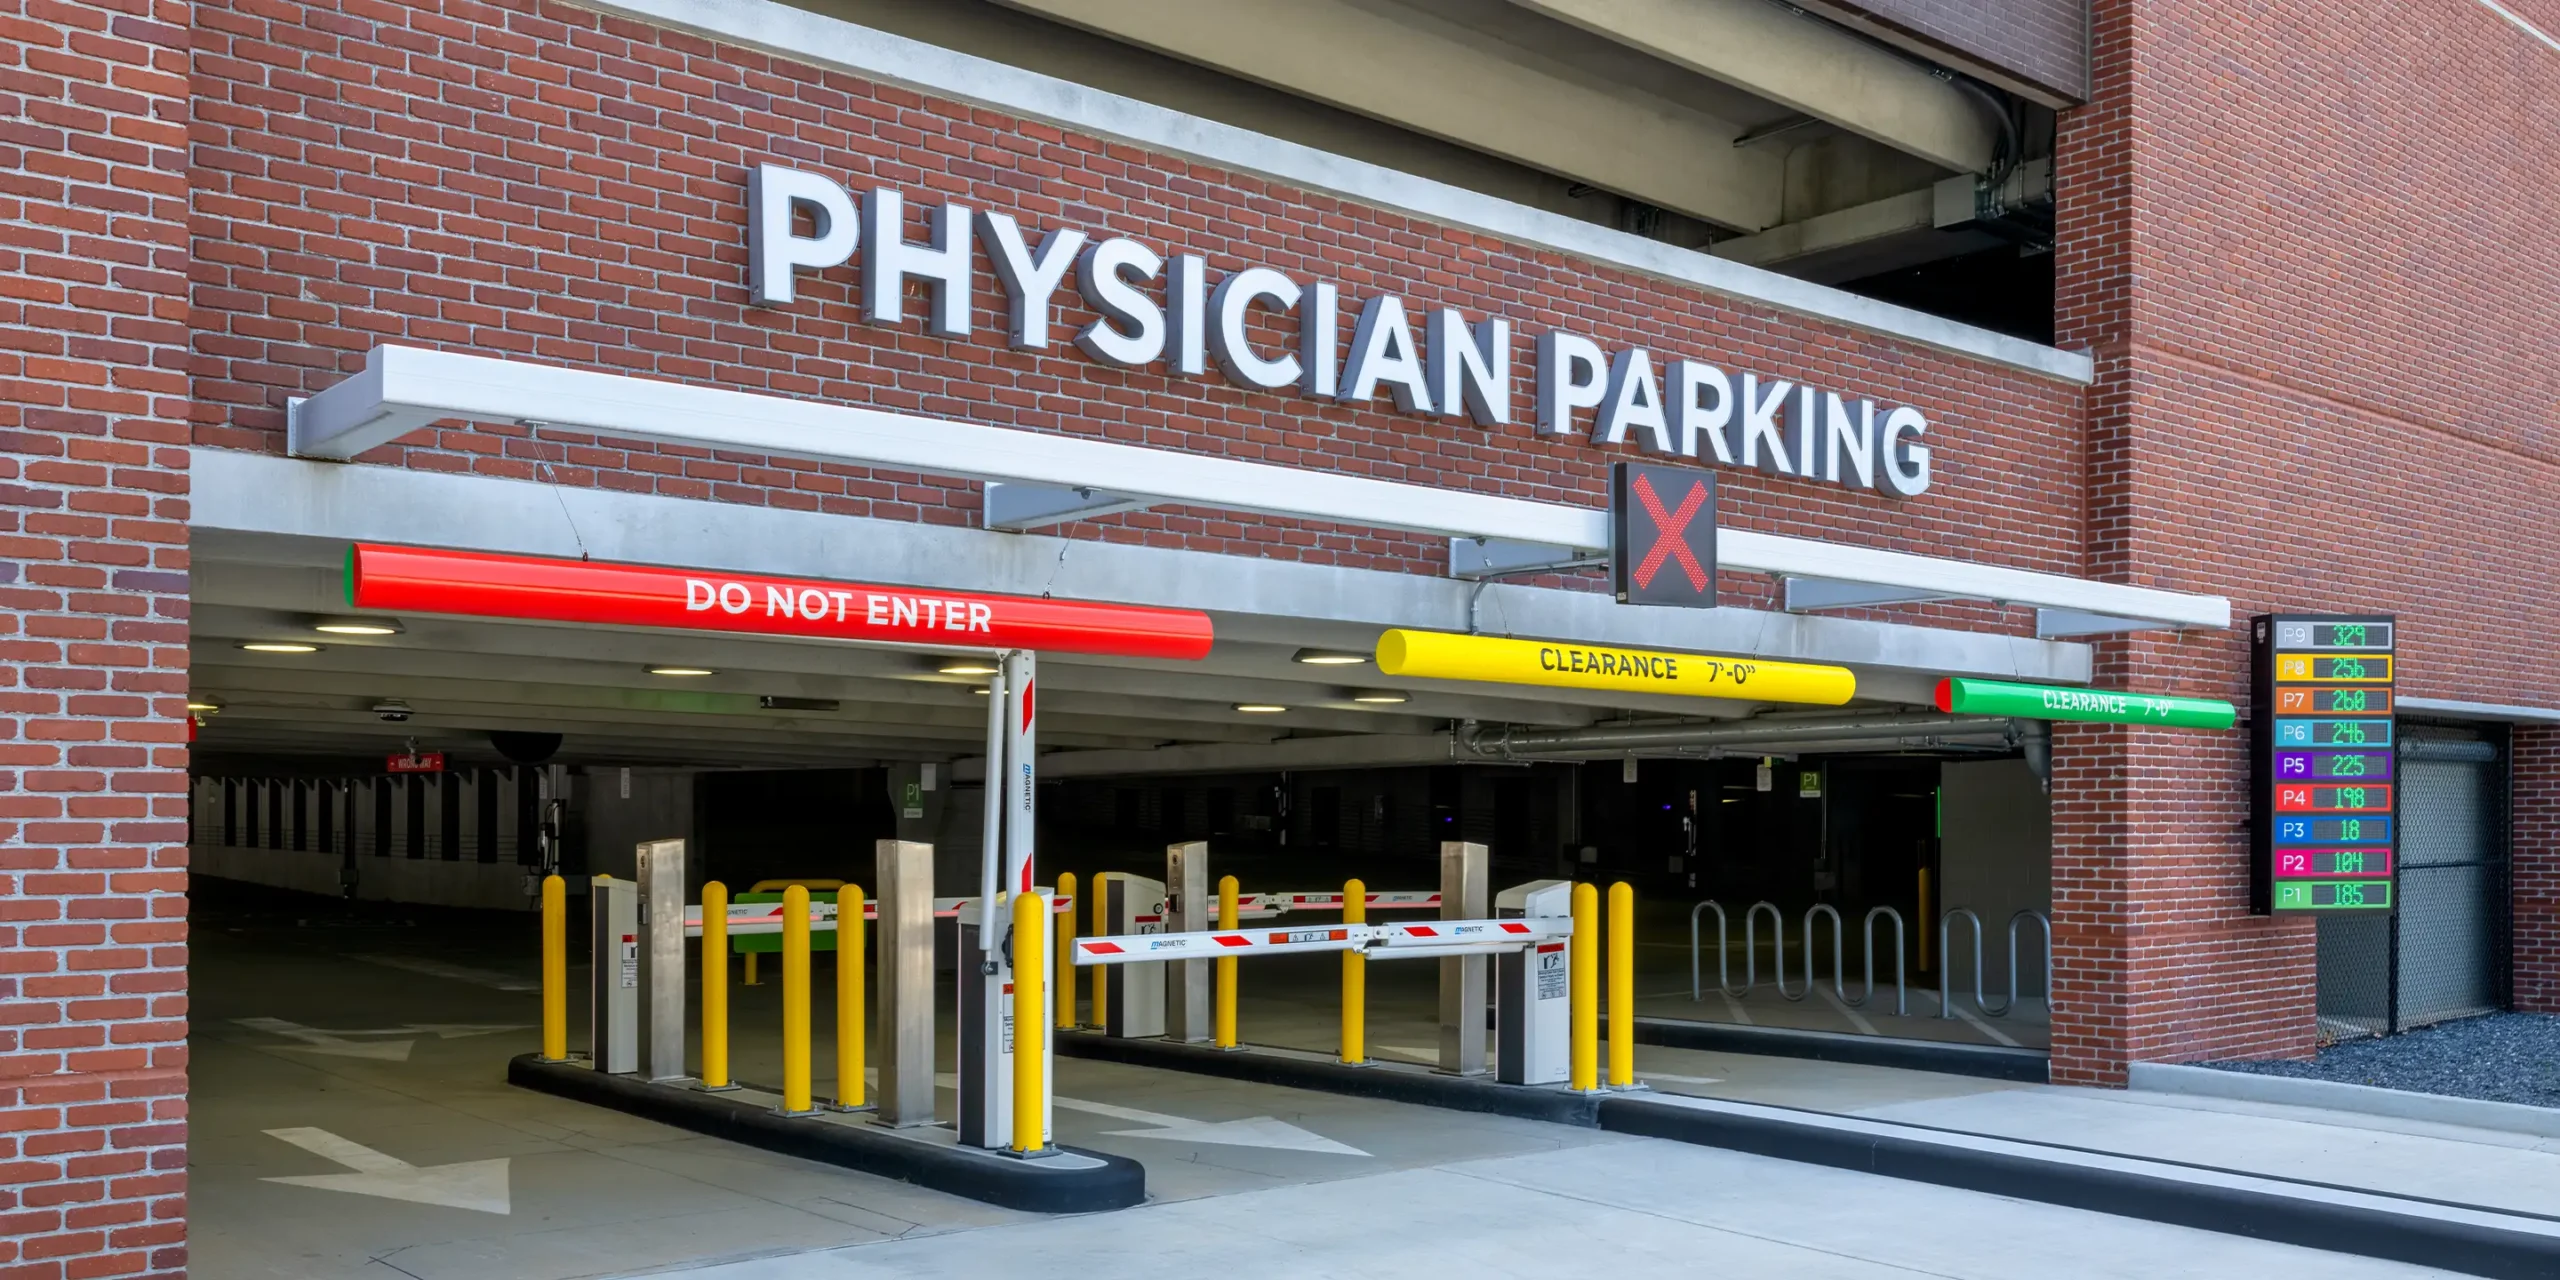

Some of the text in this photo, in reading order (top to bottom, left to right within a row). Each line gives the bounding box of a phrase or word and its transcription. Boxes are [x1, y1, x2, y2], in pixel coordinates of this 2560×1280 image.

[748, 163, 1932, 496] PHYSICIAN PARKING
[686, 578, 992, 633] DO NOT ENTER
[2284, 628, 2306, 643] P9
[2333, 624, 2366, 647] 329
[1540, 647, 1678, 680] CLEARANCE
[2283, 657, 2365, 679] P8 256
[2042, 689, 2126, 714] CLEARANCE
[2283, 690, 2365, 711] P7 260
[2283, 722, 2365, 744] P6 246
[2283, 754, 2365, 776] P5 225
[1803, 773, 1818, 786] P1
[906, 783, 920, 801] P1
[2283, 788, 2365, 809] P4 198
[2283, 819, 2360, 841] P3 18
[2283, 852, 2364, 874] P2 104
[2282, 884, 2364, 906] P1 185
